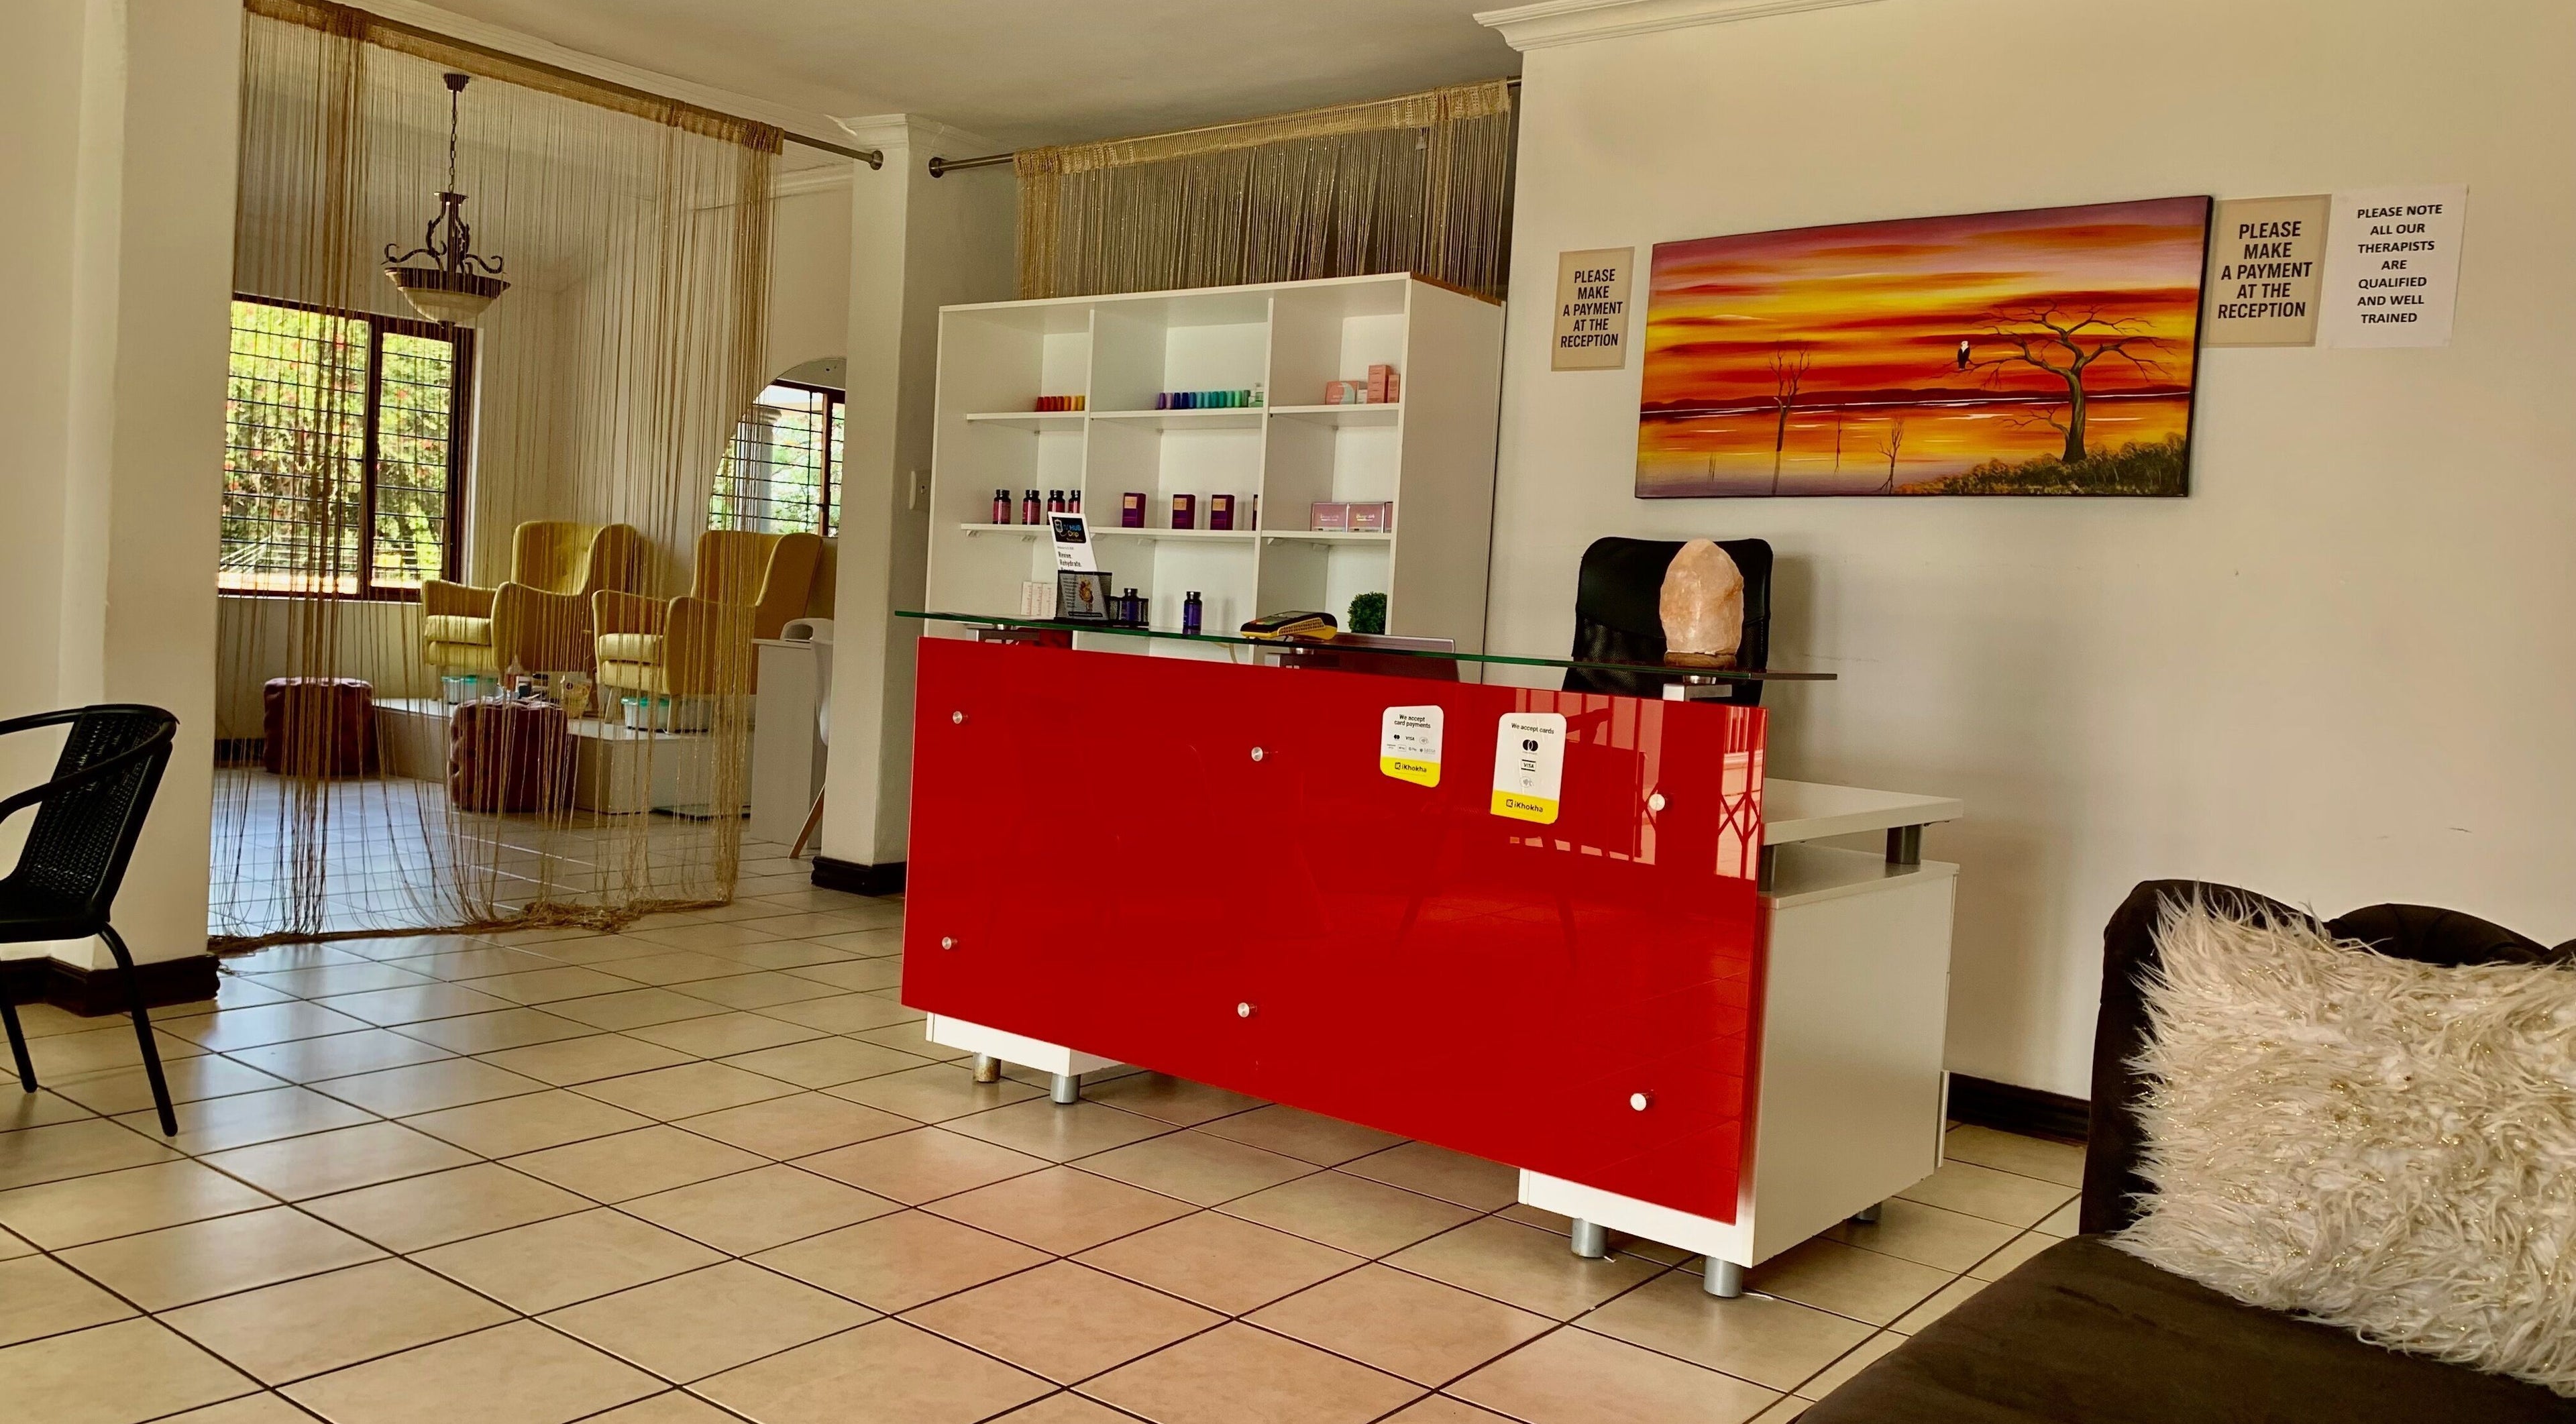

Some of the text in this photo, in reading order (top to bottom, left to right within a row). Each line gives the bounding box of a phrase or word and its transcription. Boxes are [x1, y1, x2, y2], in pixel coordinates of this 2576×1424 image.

[2357, 204, 2443, 219] PLEASE NOTE
[2239, 221, 2302, 239] PLEASE
[2370, 223, 2425, 235] ALL OUR
[2244, 242, 2292, 260] MAKE
[2358, 240, 2435, 254] THERAPISTS
[2221, 262, 2312, 280] A PAYMENT
[2381, 260, 2407, 270] ARE
[1574, 268, 1615, 283] PLEASE
[2358, 276, 2427, 290] QUALIFIED
[1578, 286, 1609, 300] MAKE
[2237, 282, 2291, 299] AT THE
[2357, 294, 2424, 307] AND WELL
[1563, 301, 1623, 317] A PAYMENT
[2218, 302, 2306, 319] RECEPTION
[1573, 318, 1609, 331] AT THE
[2361, 313, 2418, 324] TRAINED
[1560, 333, 1618, 348] RECEPTION
[1402, 764, 1427, 773] iKhokha
[1514, 801, 1543, 812] iKhokha
